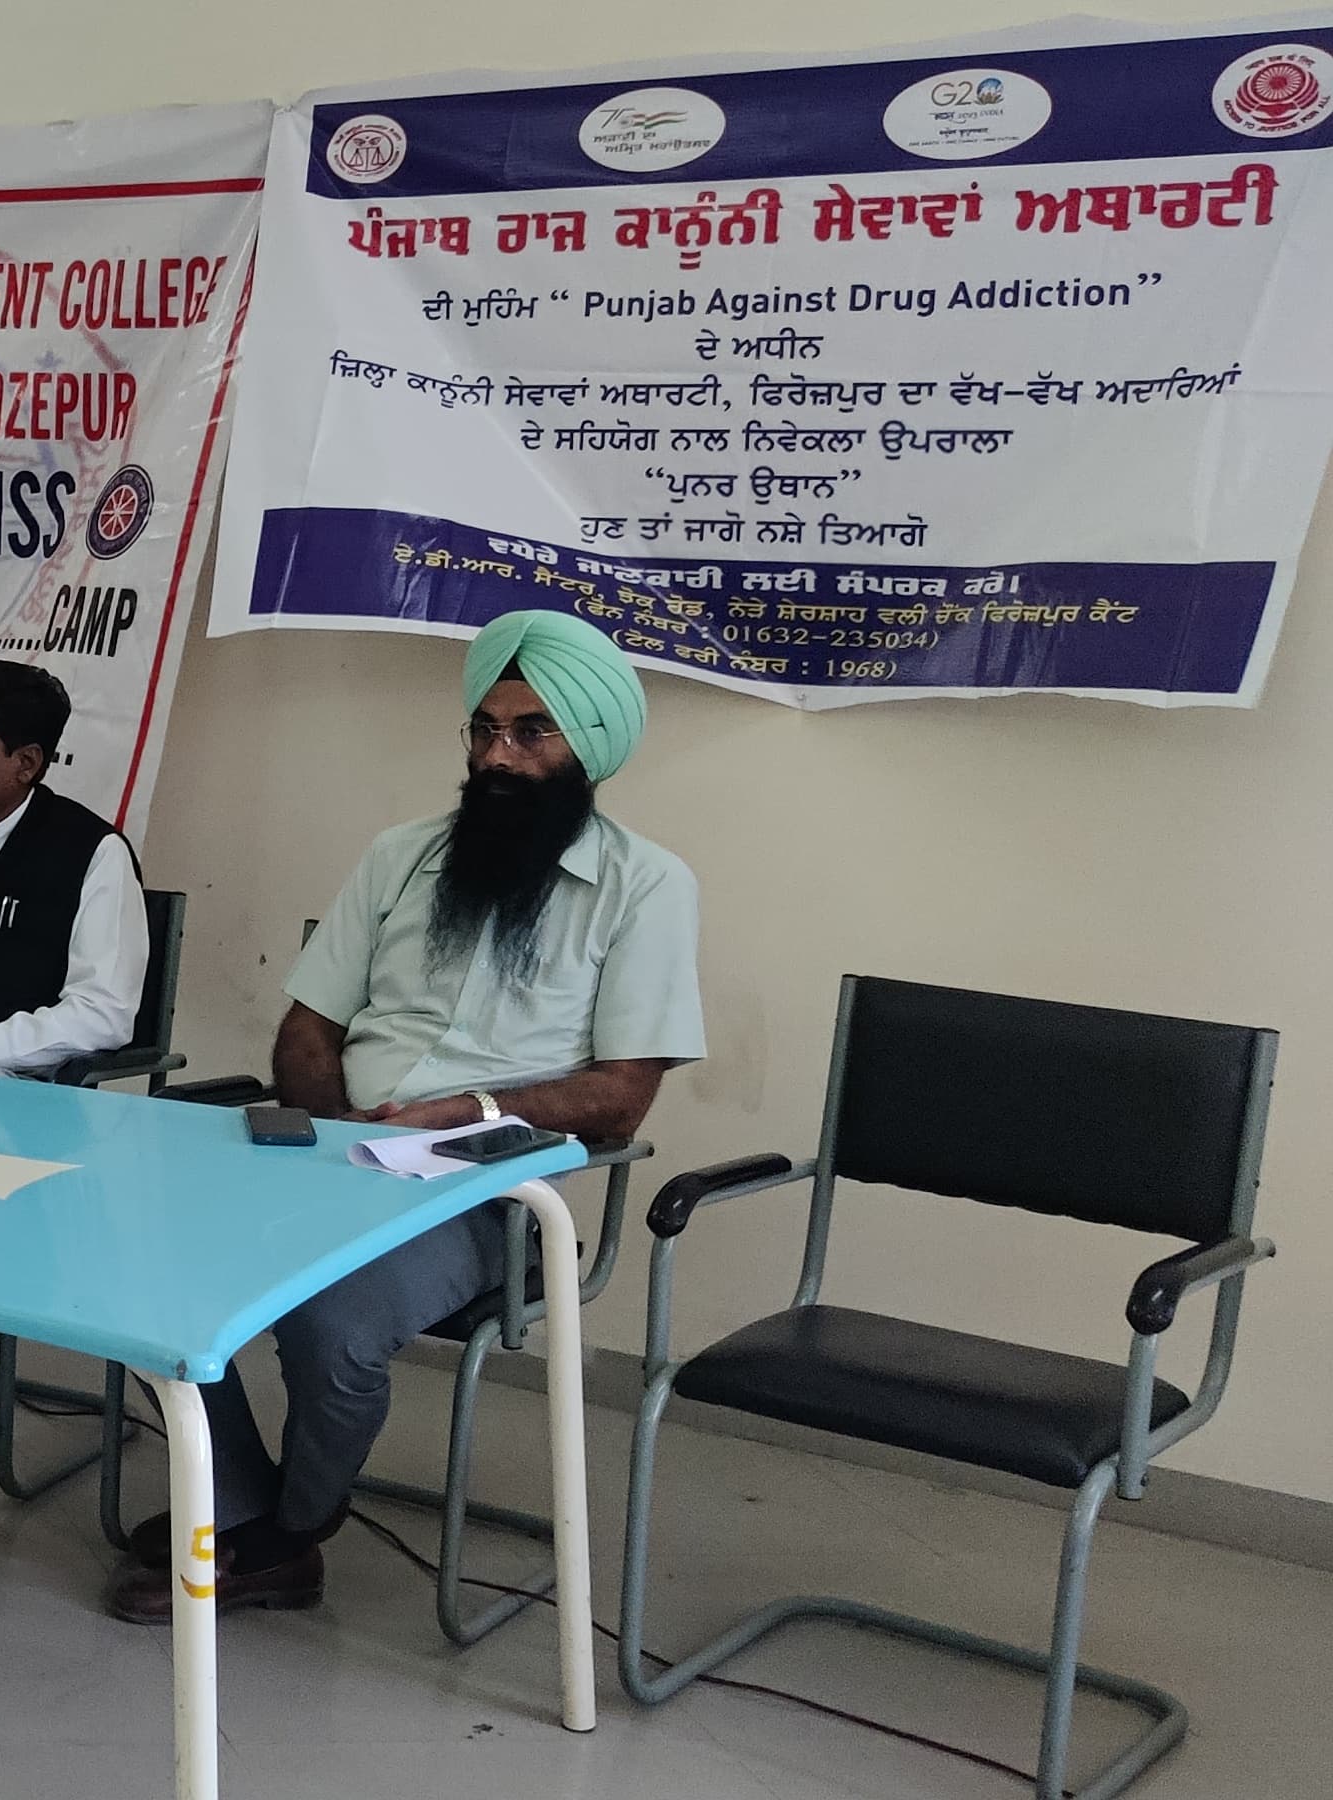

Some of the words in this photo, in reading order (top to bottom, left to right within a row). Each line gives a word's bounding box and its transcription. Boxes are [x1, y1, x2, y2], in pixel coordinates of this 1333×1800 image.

[348, 206, 471, 259] ਪੰਜਾਬ
[496, 209, 586, 254] ਰਾਜ
[615, 187, 783, 271] ਕਾਨੂੰਨੀ
[813, 181, 983, 243] ਸੇਵਾਵਾਂ
[1015, 163, 1282, 234] ਅਥਾਰਟੀ
[422, 290, 453, 321] ਦੀ
[463, 287, 538, 327] ਮੁਹਿੰਮ
[583, 287, 696, 323] Punjab
[705, 285, 837, 321] Against
[849, 283, 937, 317] Drug
[695, 329, 720, 360] ਦੇ
[732, 327, 824, 360] ਅਧੀਨ
[407, 371, 494, 408] ਕਾਨੂੰਨੀ
[505, 376, 589, 406] ਸੇਵਾਵਾਂ
[600, 373, 732, 411] ਅਥਾਰਟੀ,
[898, 381, 937, 405] ਦਾ
[1095, 362, 1242, 405] ਅਦਾਰਿਆਂ
[521, 420, 544, 450] ਦੇ
[554, 419, 660, 451] ਸਹਿਯੋਗ
[670, 428, 731, 451] ਨਾਲ
[742, 419, 867, 452] ਨਿਵੇਕਲਾ
[879, 419, 1014, 460] ਉਪਰਾਲਾ
[580, 517, 628, 543] ਹੁਣ
[638, 512, 674, 540] ਤਾਂ
[683, 510, 745, 543] ਜਾਗੋ
[756, 512, 807, 543] ਨਸ਼ੇ
[818, 512, 928, 547] ਤਿਆਗੋ
[575, 557, 724, 590] ਜਾਣਕਾਰੀ
[741, 568, 817, 593] ਲਈ
[836, 570, 948, 597] ਸੰਪਰਕ
[43, 584, 138, 658] CAMP
[633, 608, 689, 635] ਨੰਬਰ
[877, 602, 928, 626] ਵਲੀ
[728, 650, 789, 674] ਨੰਬਰ
[826, 659, 897, 680] 1968)
